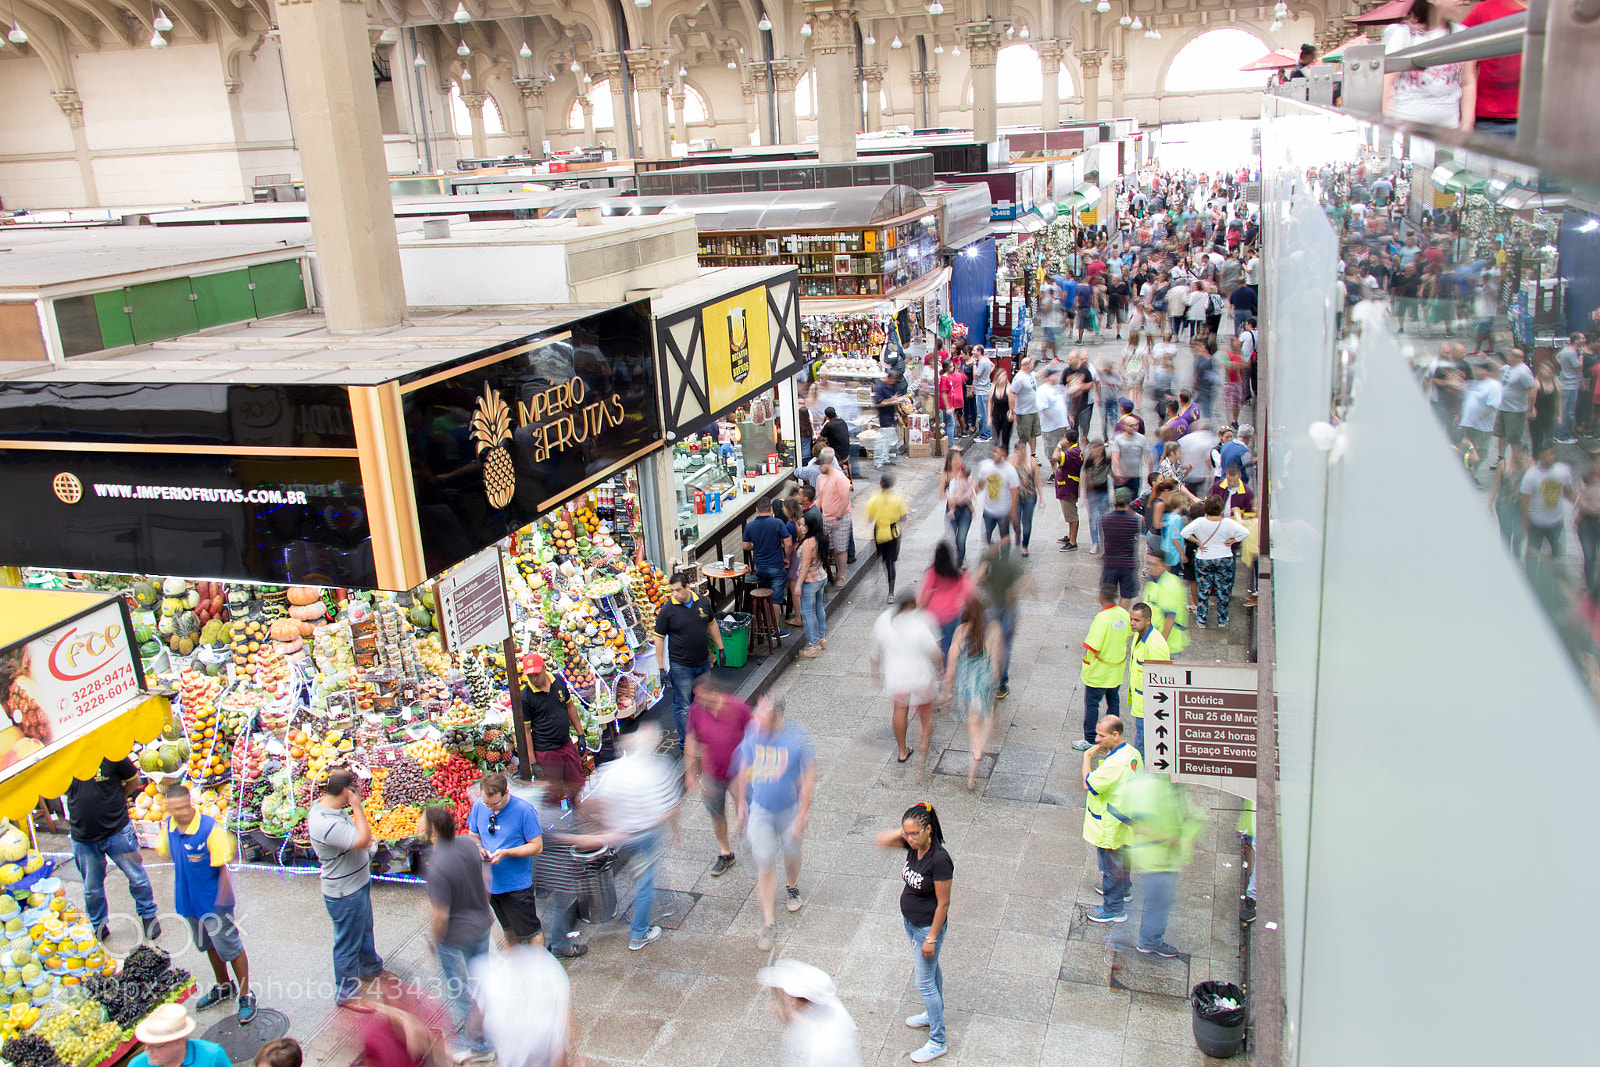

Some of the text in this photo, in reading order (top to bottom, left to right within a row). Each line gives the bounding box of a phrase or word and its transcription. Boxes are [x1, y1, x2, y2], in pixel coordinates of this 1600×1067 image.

[518, 376, 585, 428] IMPÉRIO
[542, 394, 624, 459] FRUTAS
[94, 484, 307, 504] WWW.IMPERIOFRUTAS.COM.BR
[72, 663, 132, 703] 3228-9474
[1148, 672, 1175, 685] Rua
[58, 677, 135, 724] Fax: 3228-6014
[1184, 694, 1224, 705] Lotérica
[1185, 711, 1204, 720] Rua
[1206, 712, 1218, 721] 25
[1220, 713, 1232, 722] de
[1185, 729, 1256, 741] Caixa 24 horas
[1185, 745, 1220, 756] Espaço
[1185, 763, 1233, 775] Revistaria
